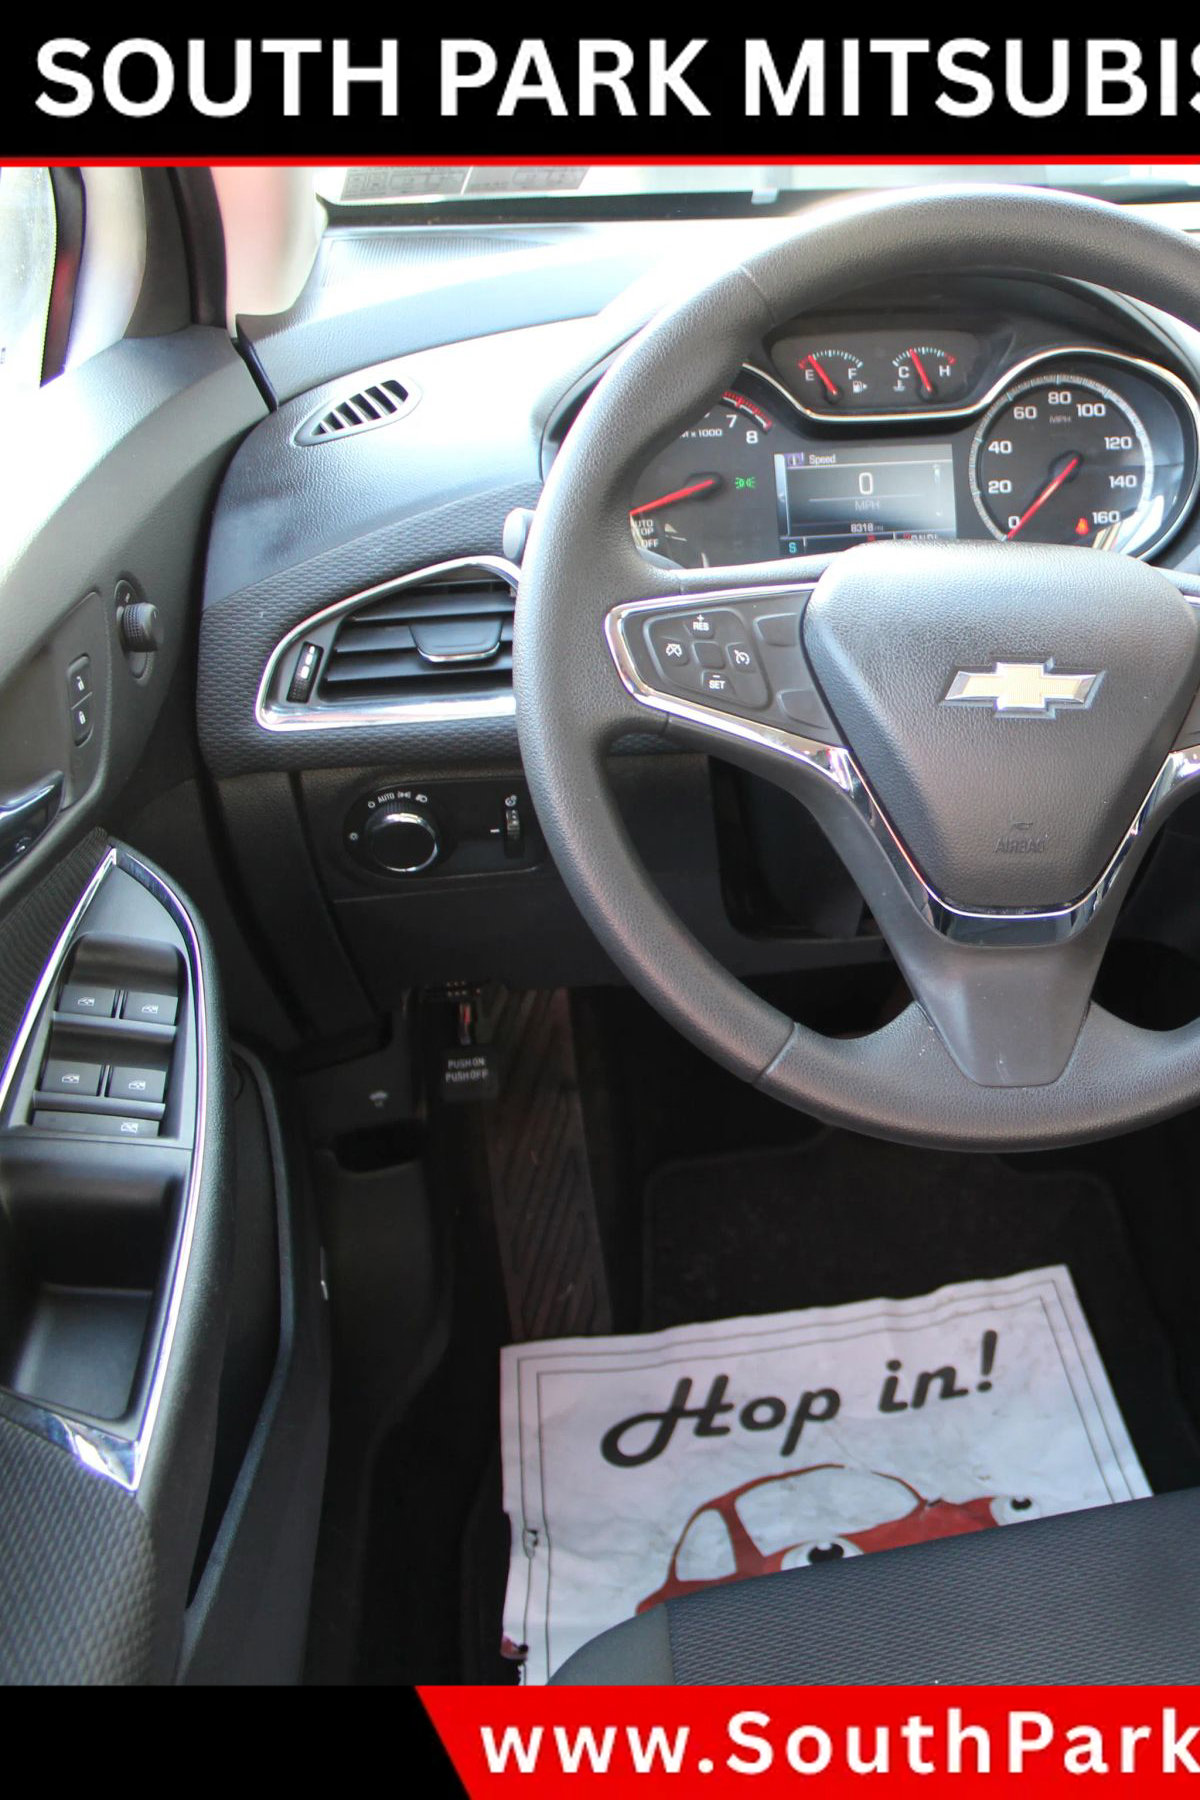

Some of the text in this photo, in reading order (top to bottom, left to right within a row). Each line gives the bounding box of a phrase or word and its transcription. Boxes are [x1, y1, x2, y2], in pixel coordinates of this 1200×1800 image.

[805, 369, 814, 381] E
[848, 368, 857, 379] F
[898, 366, 910, 378] C
[939, 365, 950, 377] H
[1048, 392, 1072, 405] 80
[1013, 406, 1037, 420] 60
[1076, 404, 1106, 418] 100
[726, 414, 738, 428] 7
[699, 428, 722, 438] 1000
[746, 430, 758, 444] 8
[988, 441, 1013, 454] 40
[1104, 436, 1133, 450] 120
[809, 455, 836, 466] Speed
[858, 472, 874, 495] 0
[988, 480, 1012, 494] 20
[1108, 475, 1137, 489] 140
[855, 500, 880, 511] MPH
[1008, 516, 1020, 528] 0
[1092, 511, 1120, 524] 160
[788, 542, 797, 554] S
[693, 620, 709, 631] RES
[709, 679, 725, 689] SET
[377, 792, 395, 803] AUTO
[448, 1057, 485, 1069] PUSH ON
[446, 1069, 488, 1082] PUSH OFF
[600, 1330, 998, 1467] Hop in!
